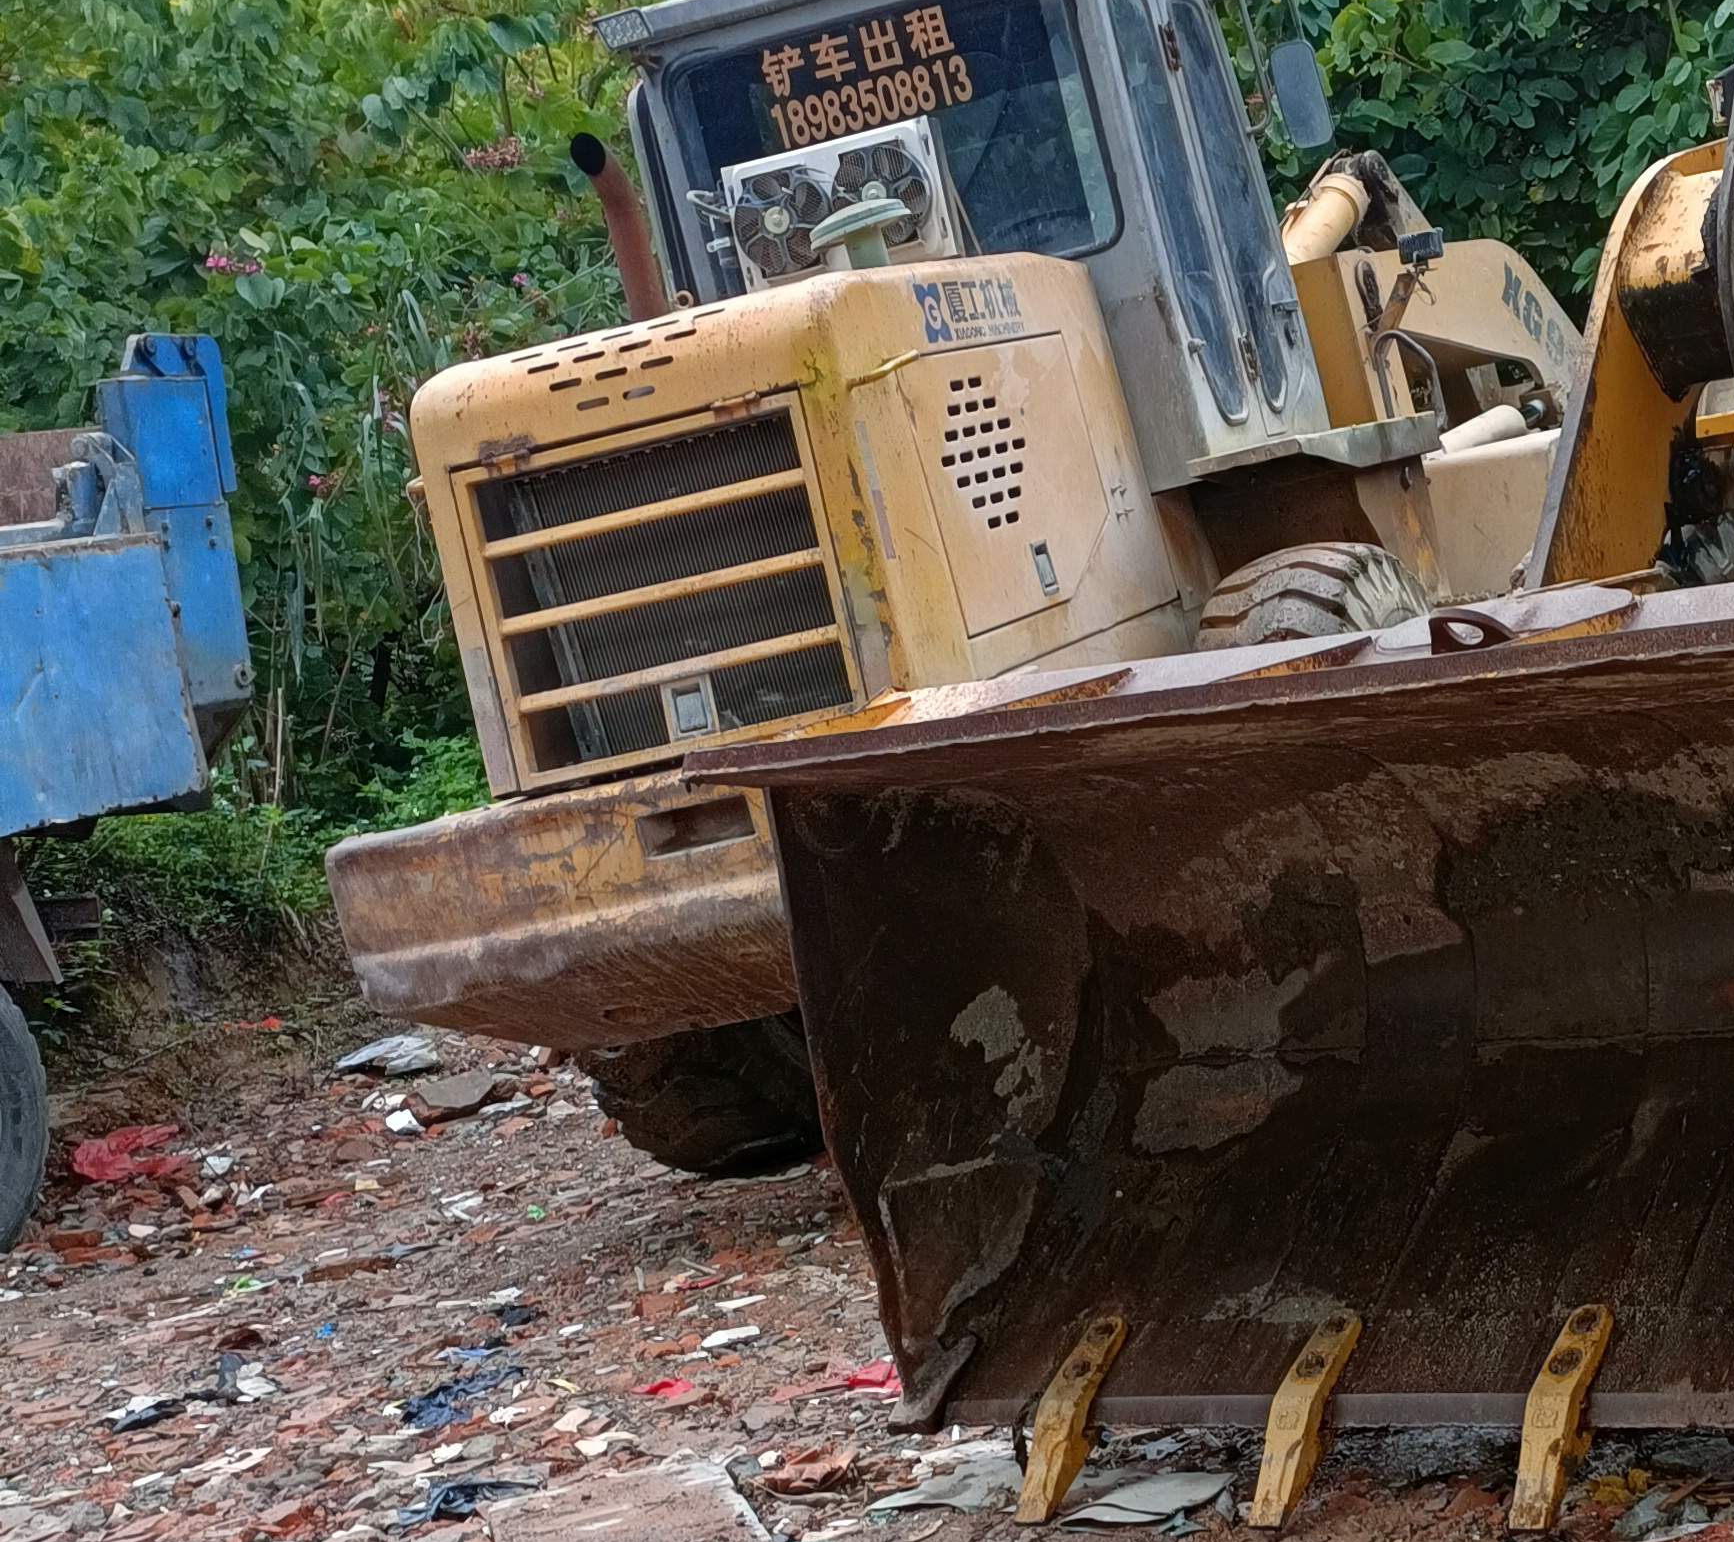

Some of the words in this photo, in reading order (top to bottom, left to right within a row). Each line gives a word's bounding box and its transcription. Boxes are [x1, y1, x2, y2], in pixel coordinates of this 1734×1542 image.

[761, 4, 955, 99] 铲车出租
[770, 54, 974, 150] 18983508813
